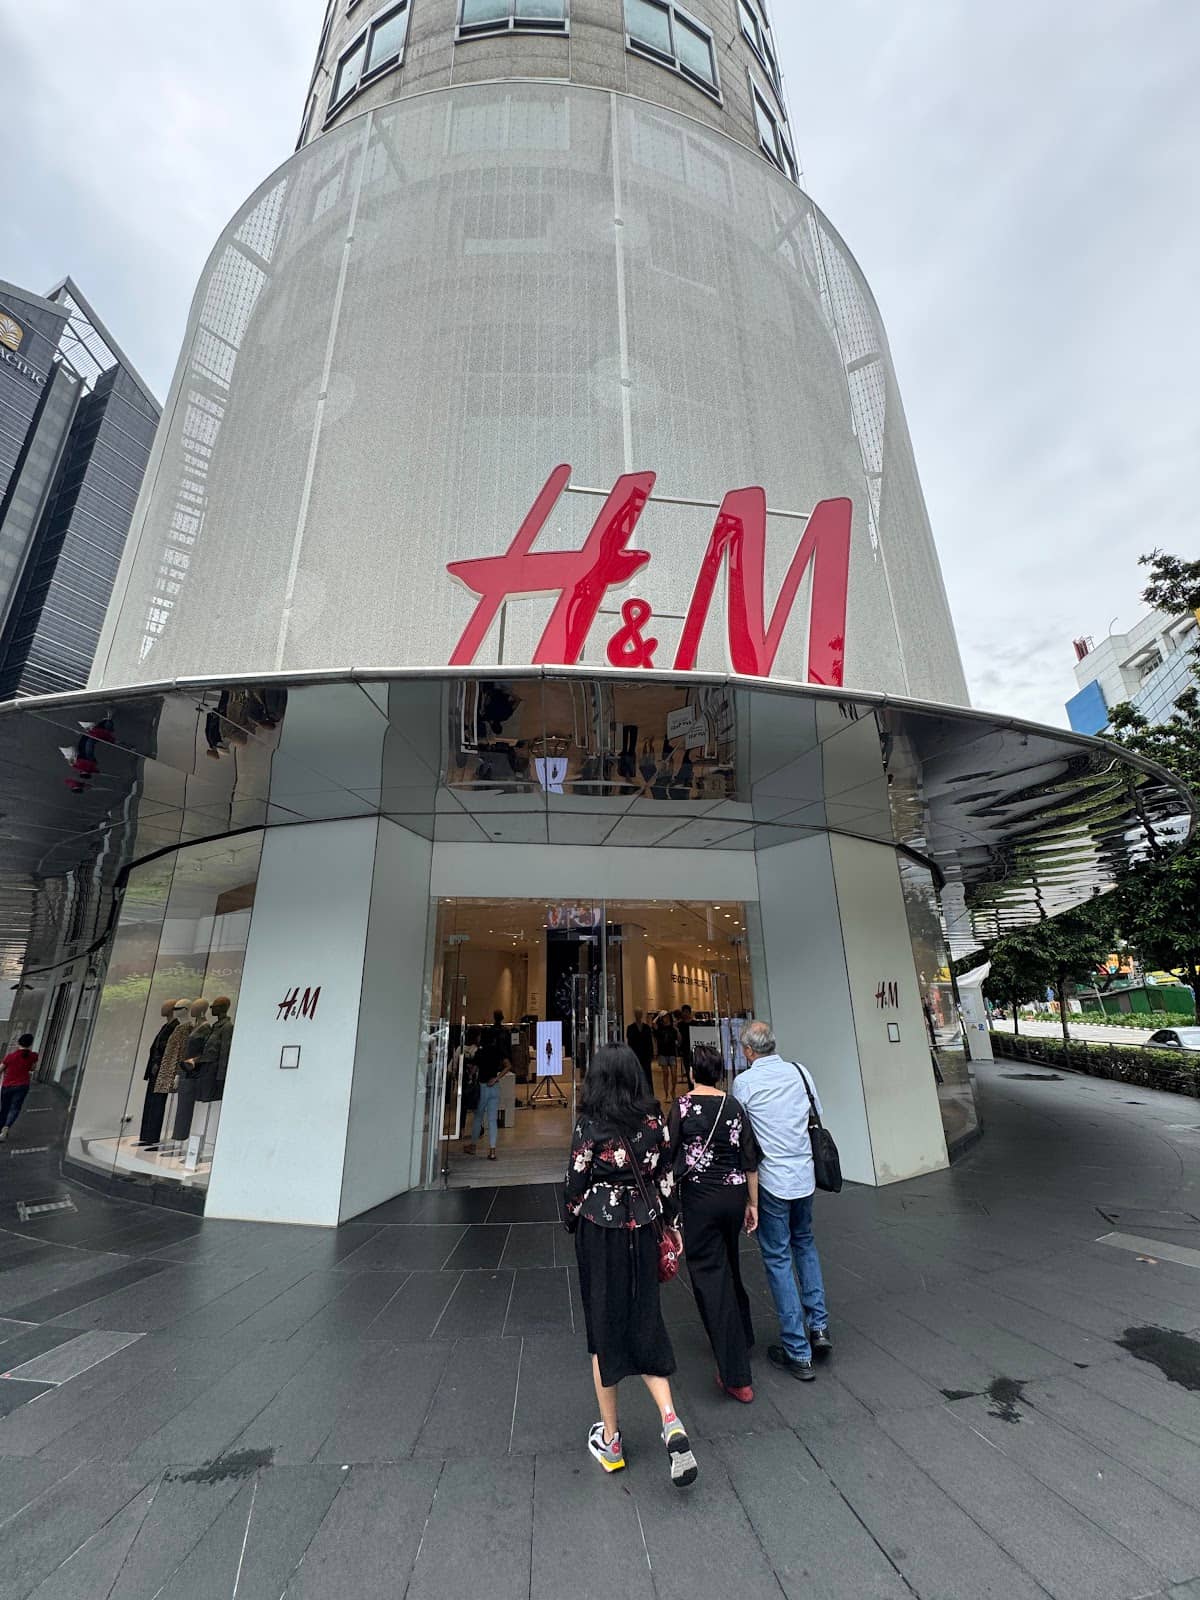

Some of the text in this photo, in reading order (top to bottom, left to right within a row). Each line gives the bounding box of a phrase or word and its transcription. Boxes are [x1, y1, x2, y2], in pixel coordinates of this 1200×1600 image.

[446, 463, 853, 688] H&M
[276, 986, 322, 1021] H&M
[875, 981, 899, 1009] H&M
